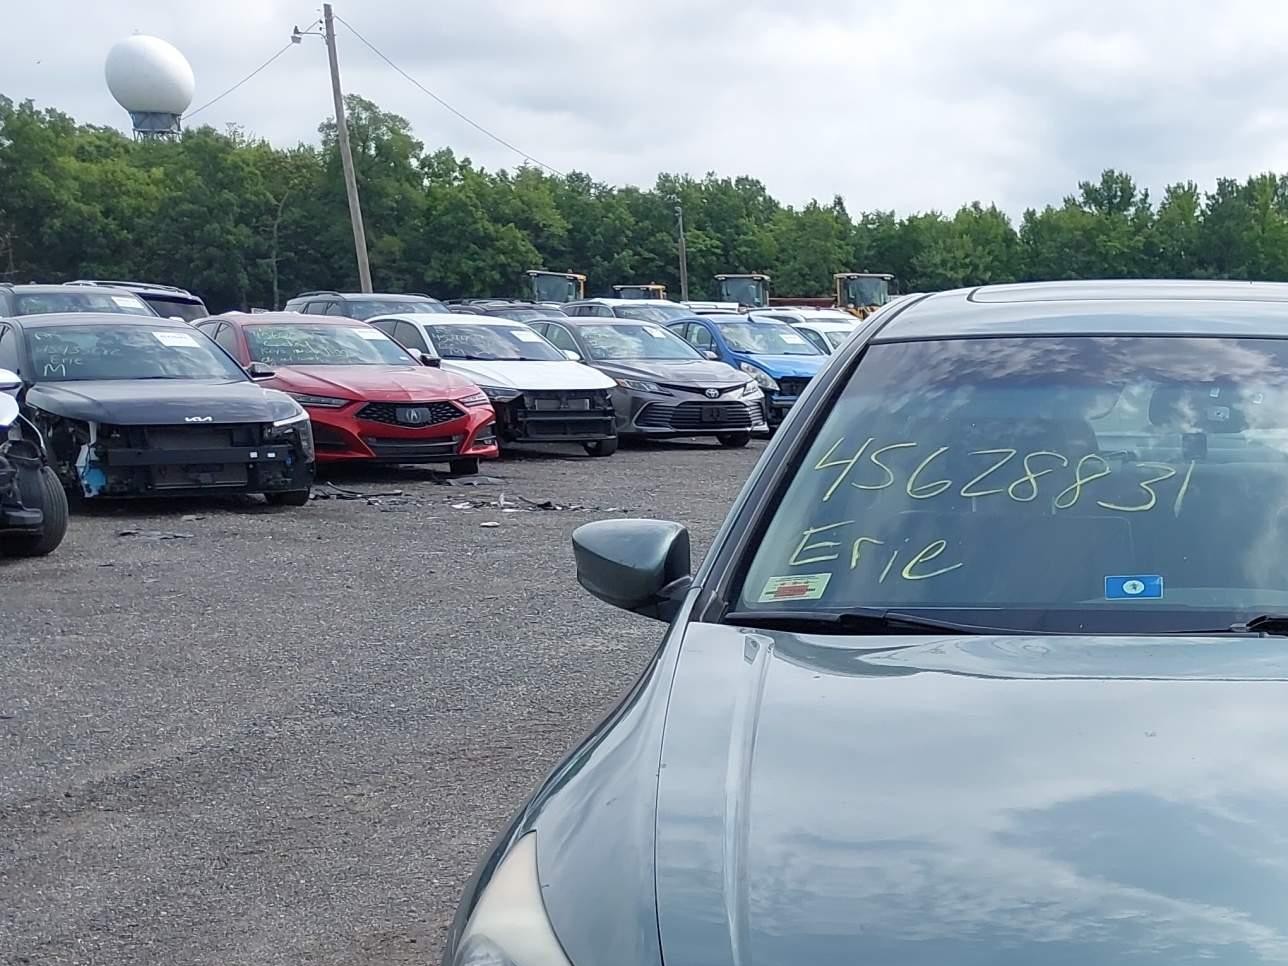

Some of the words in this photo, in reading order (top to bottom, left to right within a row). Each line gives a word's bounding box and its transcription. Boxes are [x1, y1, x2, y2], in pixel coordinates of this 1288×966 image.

[43, 363, 66, 377] M
[814, 436, 1196, 518] 45628831
[788, 520, 964, 584] Erie
